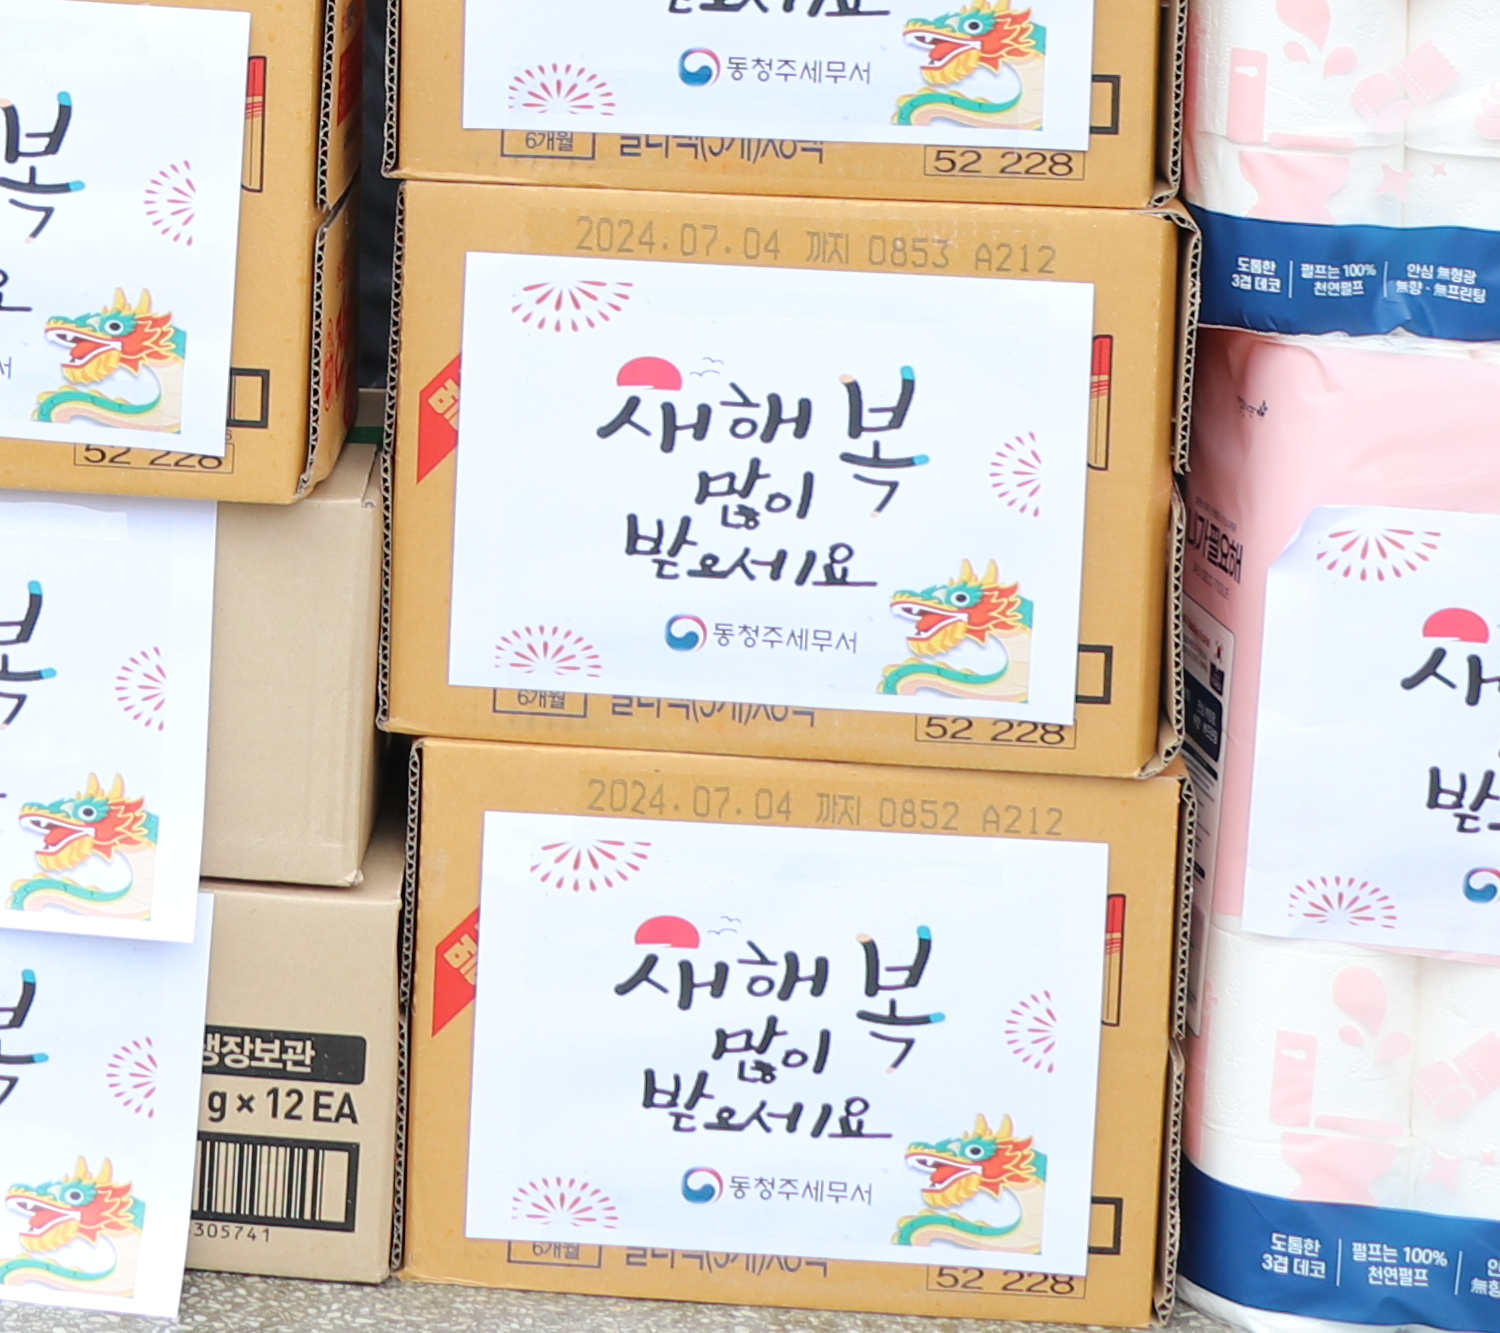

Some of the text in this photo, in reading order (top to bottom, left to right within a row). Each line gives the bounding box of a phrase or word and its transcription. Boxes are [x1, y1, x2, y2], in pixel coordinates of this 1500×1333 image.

[727, 53, 872, 86] 동청주세무서
[524, 131, 575, 154] 6개월
[933, 149, 1074, 177] 52 228
[575, 215, 1057, 274] 2024.07.04 까지 0853 A212
[1231, 274, 1283, 294] 3겹 데코
[1342, 261, 1378, 279] 100%
[1406, 262, 1436, 280] 안심
[1313, 279, 1365, 299] 천연펄프
[597, 366, 930, 519] 새해 복
[694, 458, 815, 531] 많이
[624, 513, 878, 587] 받으세요
[713, 621, 859, 656] 동청주세무서
[924, 716, 1067, 749] 52 228
[588, 777, 1065, 837] 2024.07.04 까지 0852 A212
[614, 925, 946, 1075] 새해 복
[711, 1016, 832, 1085] 많이
[642, 1067, 894, 1139] 받으세요
[730, 1174, 874, 1207] 동청주세무서
[1271, 1233, 1322, 1257] 도톰한
[1351, 1242, 1448, 1268] 펄프는 100%
[935, 1265, 1076, 1296] 52 228
[1261, 1253, 1327, 1280] 3겹 데코
[1368, 1265, 1430, 1288] 천연펄프
